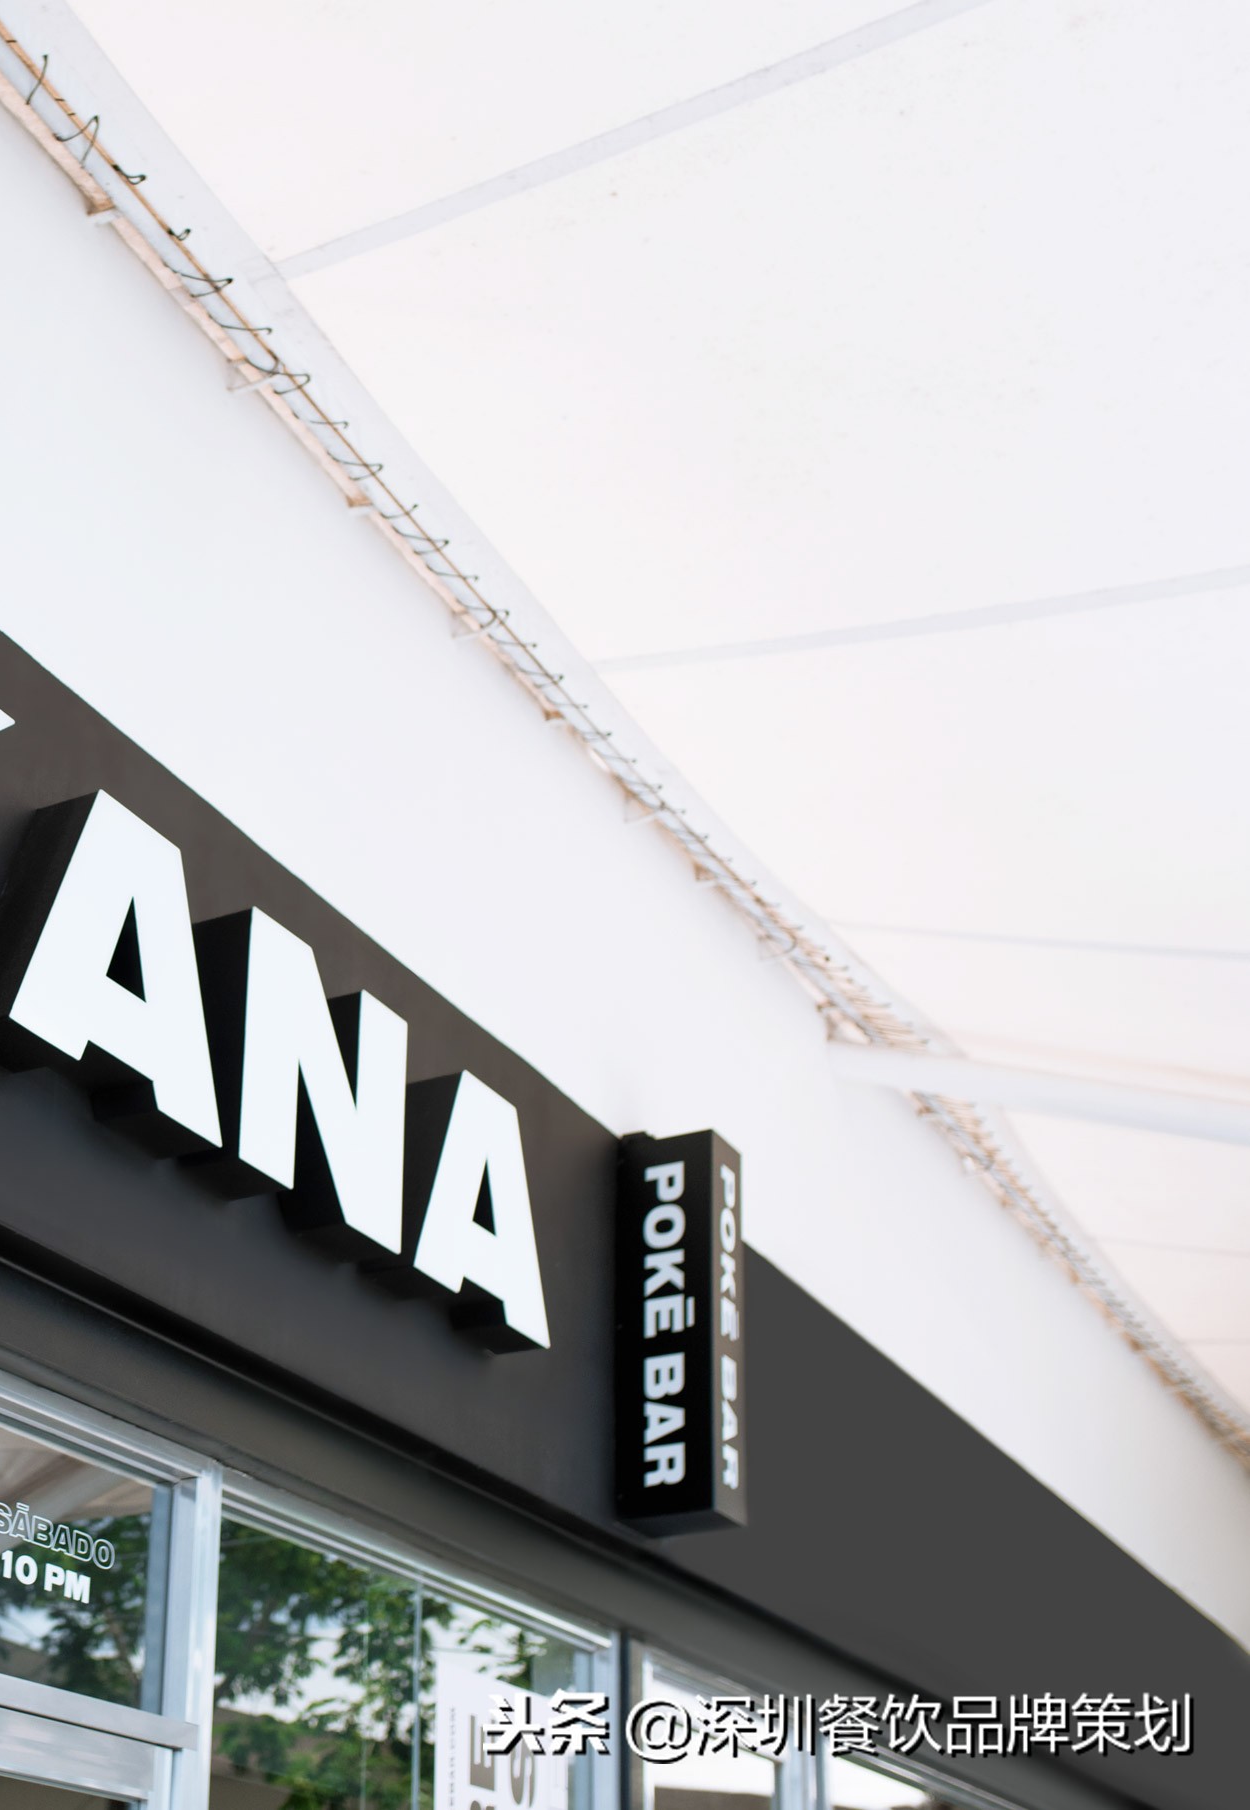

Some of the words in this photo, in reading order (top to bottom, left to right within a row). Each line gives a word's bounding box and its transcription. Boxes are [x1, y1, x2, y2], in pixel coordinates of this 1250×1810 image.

[643, 1352, 686, 1488] BAR
[720, 1354, 739, 1491] BAR
[1, 1549, 39, 1586] 10
[43, 1562, 92, 1605] PM
